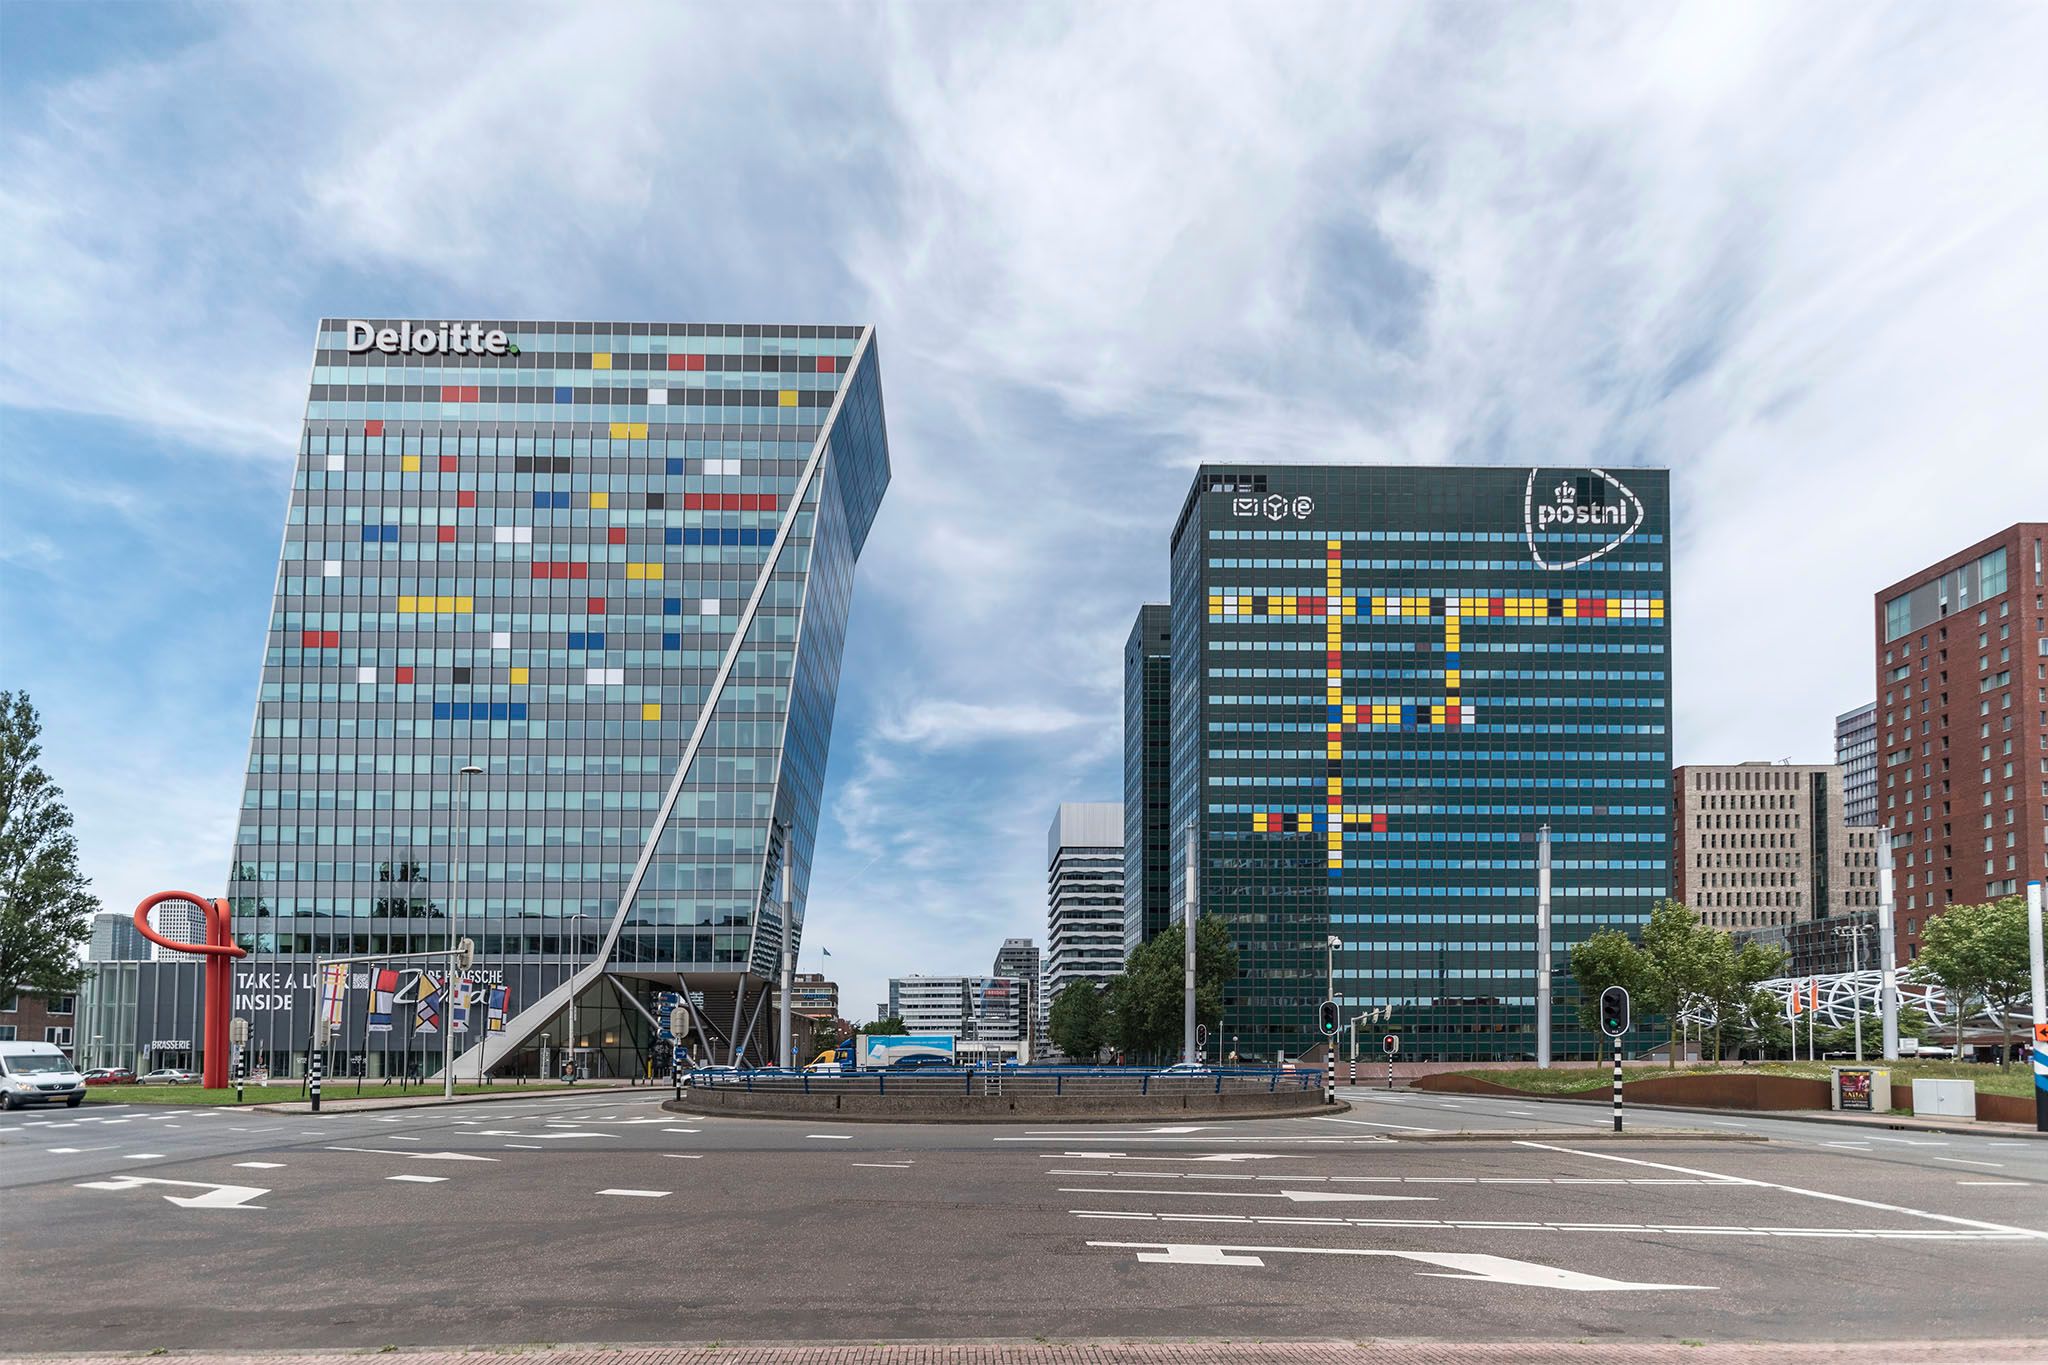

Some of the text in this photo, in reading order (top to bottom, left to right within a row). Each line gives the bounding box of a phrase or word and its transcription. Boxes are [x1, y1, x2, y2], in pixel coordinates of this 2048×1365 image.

[1538, 498, 1627, 531] postnl
[236, 973, 281, 989] TAKE
[284, 973, 298, 989] A
[235, 994, 293, 1010] INSIDE
[151, 1040, 192, 1050] BRASSERIE
